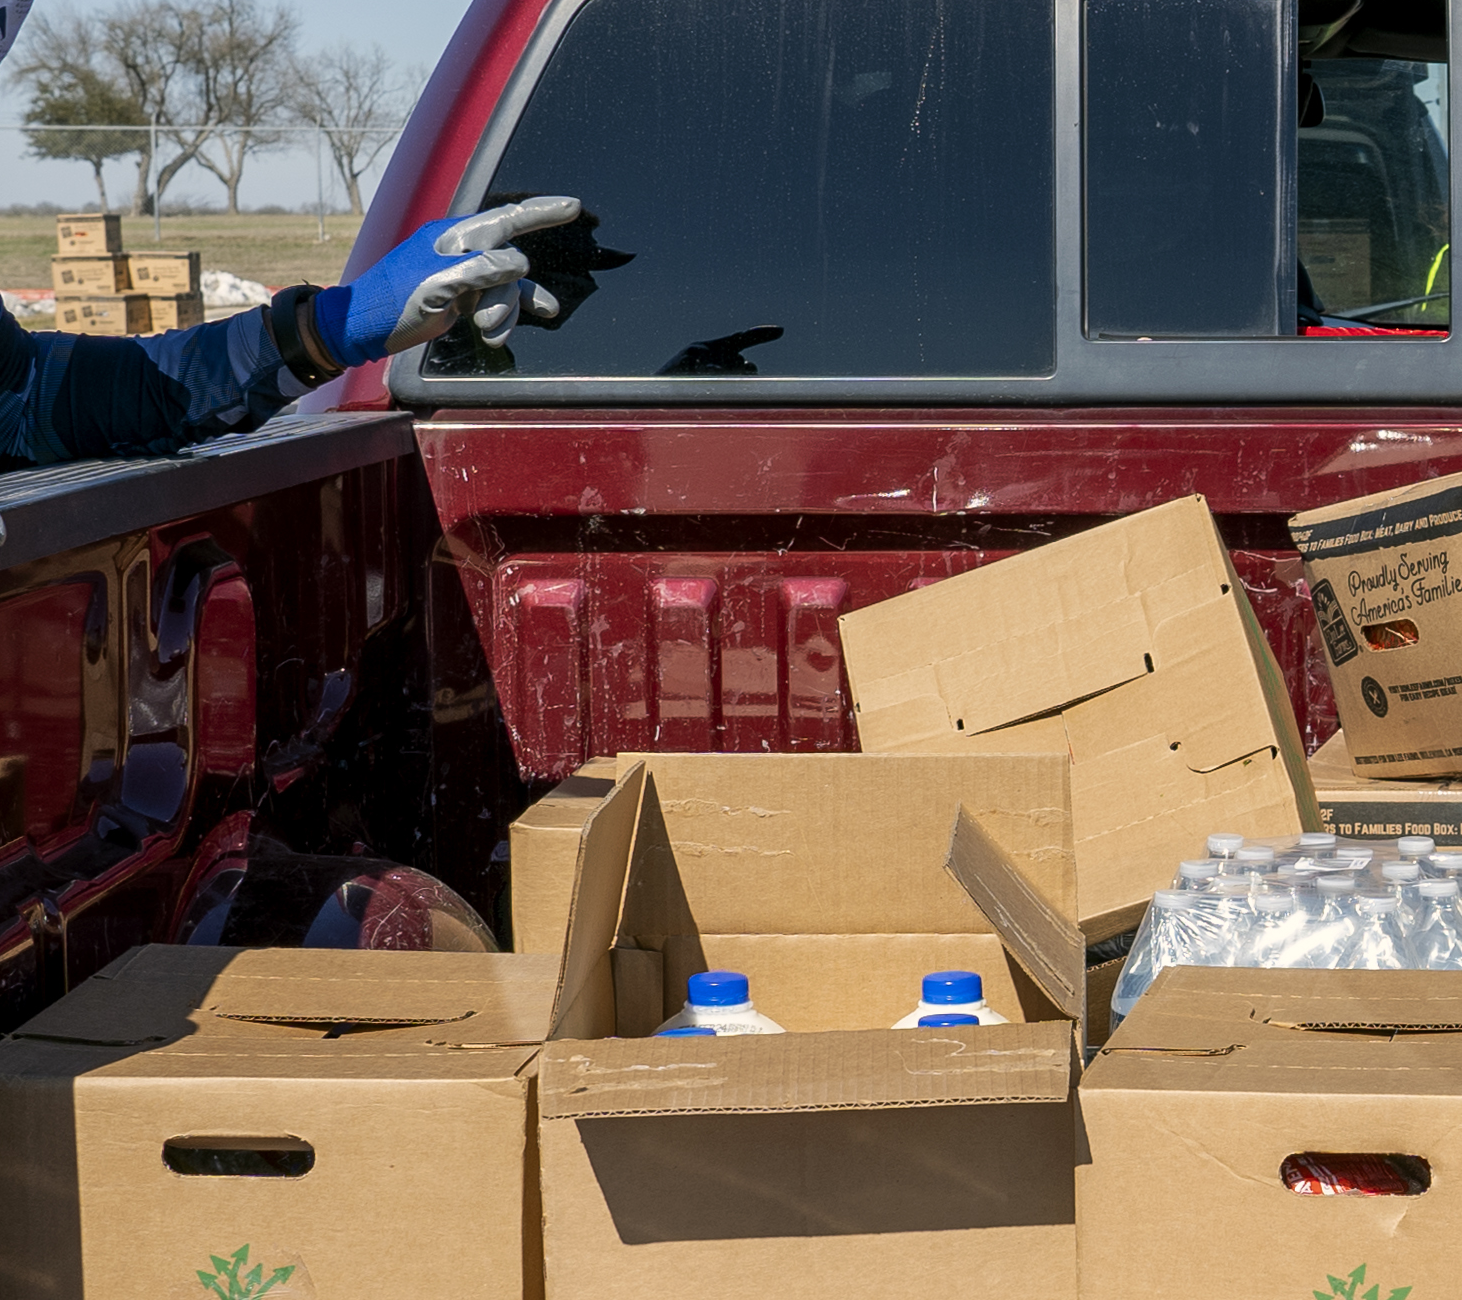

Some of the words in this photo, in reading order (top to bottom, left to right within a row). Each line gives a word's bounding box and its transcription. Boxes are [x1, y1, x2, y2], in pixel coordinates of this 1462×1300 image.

[1318, 535, 1345, 550] FAMILIES
[1348, 565, 1400, 597] Proudly
[1397, 551, 1450, 581] Serving
[1351, 586, 1413, 626] America's
[1339, 824, 1352, 836] TO
[1354, 823, 1402, 836] FAMILIES
[1404, 823, 1432, 836] FOOD
[1433, 823, 1458, 836] BOX:
